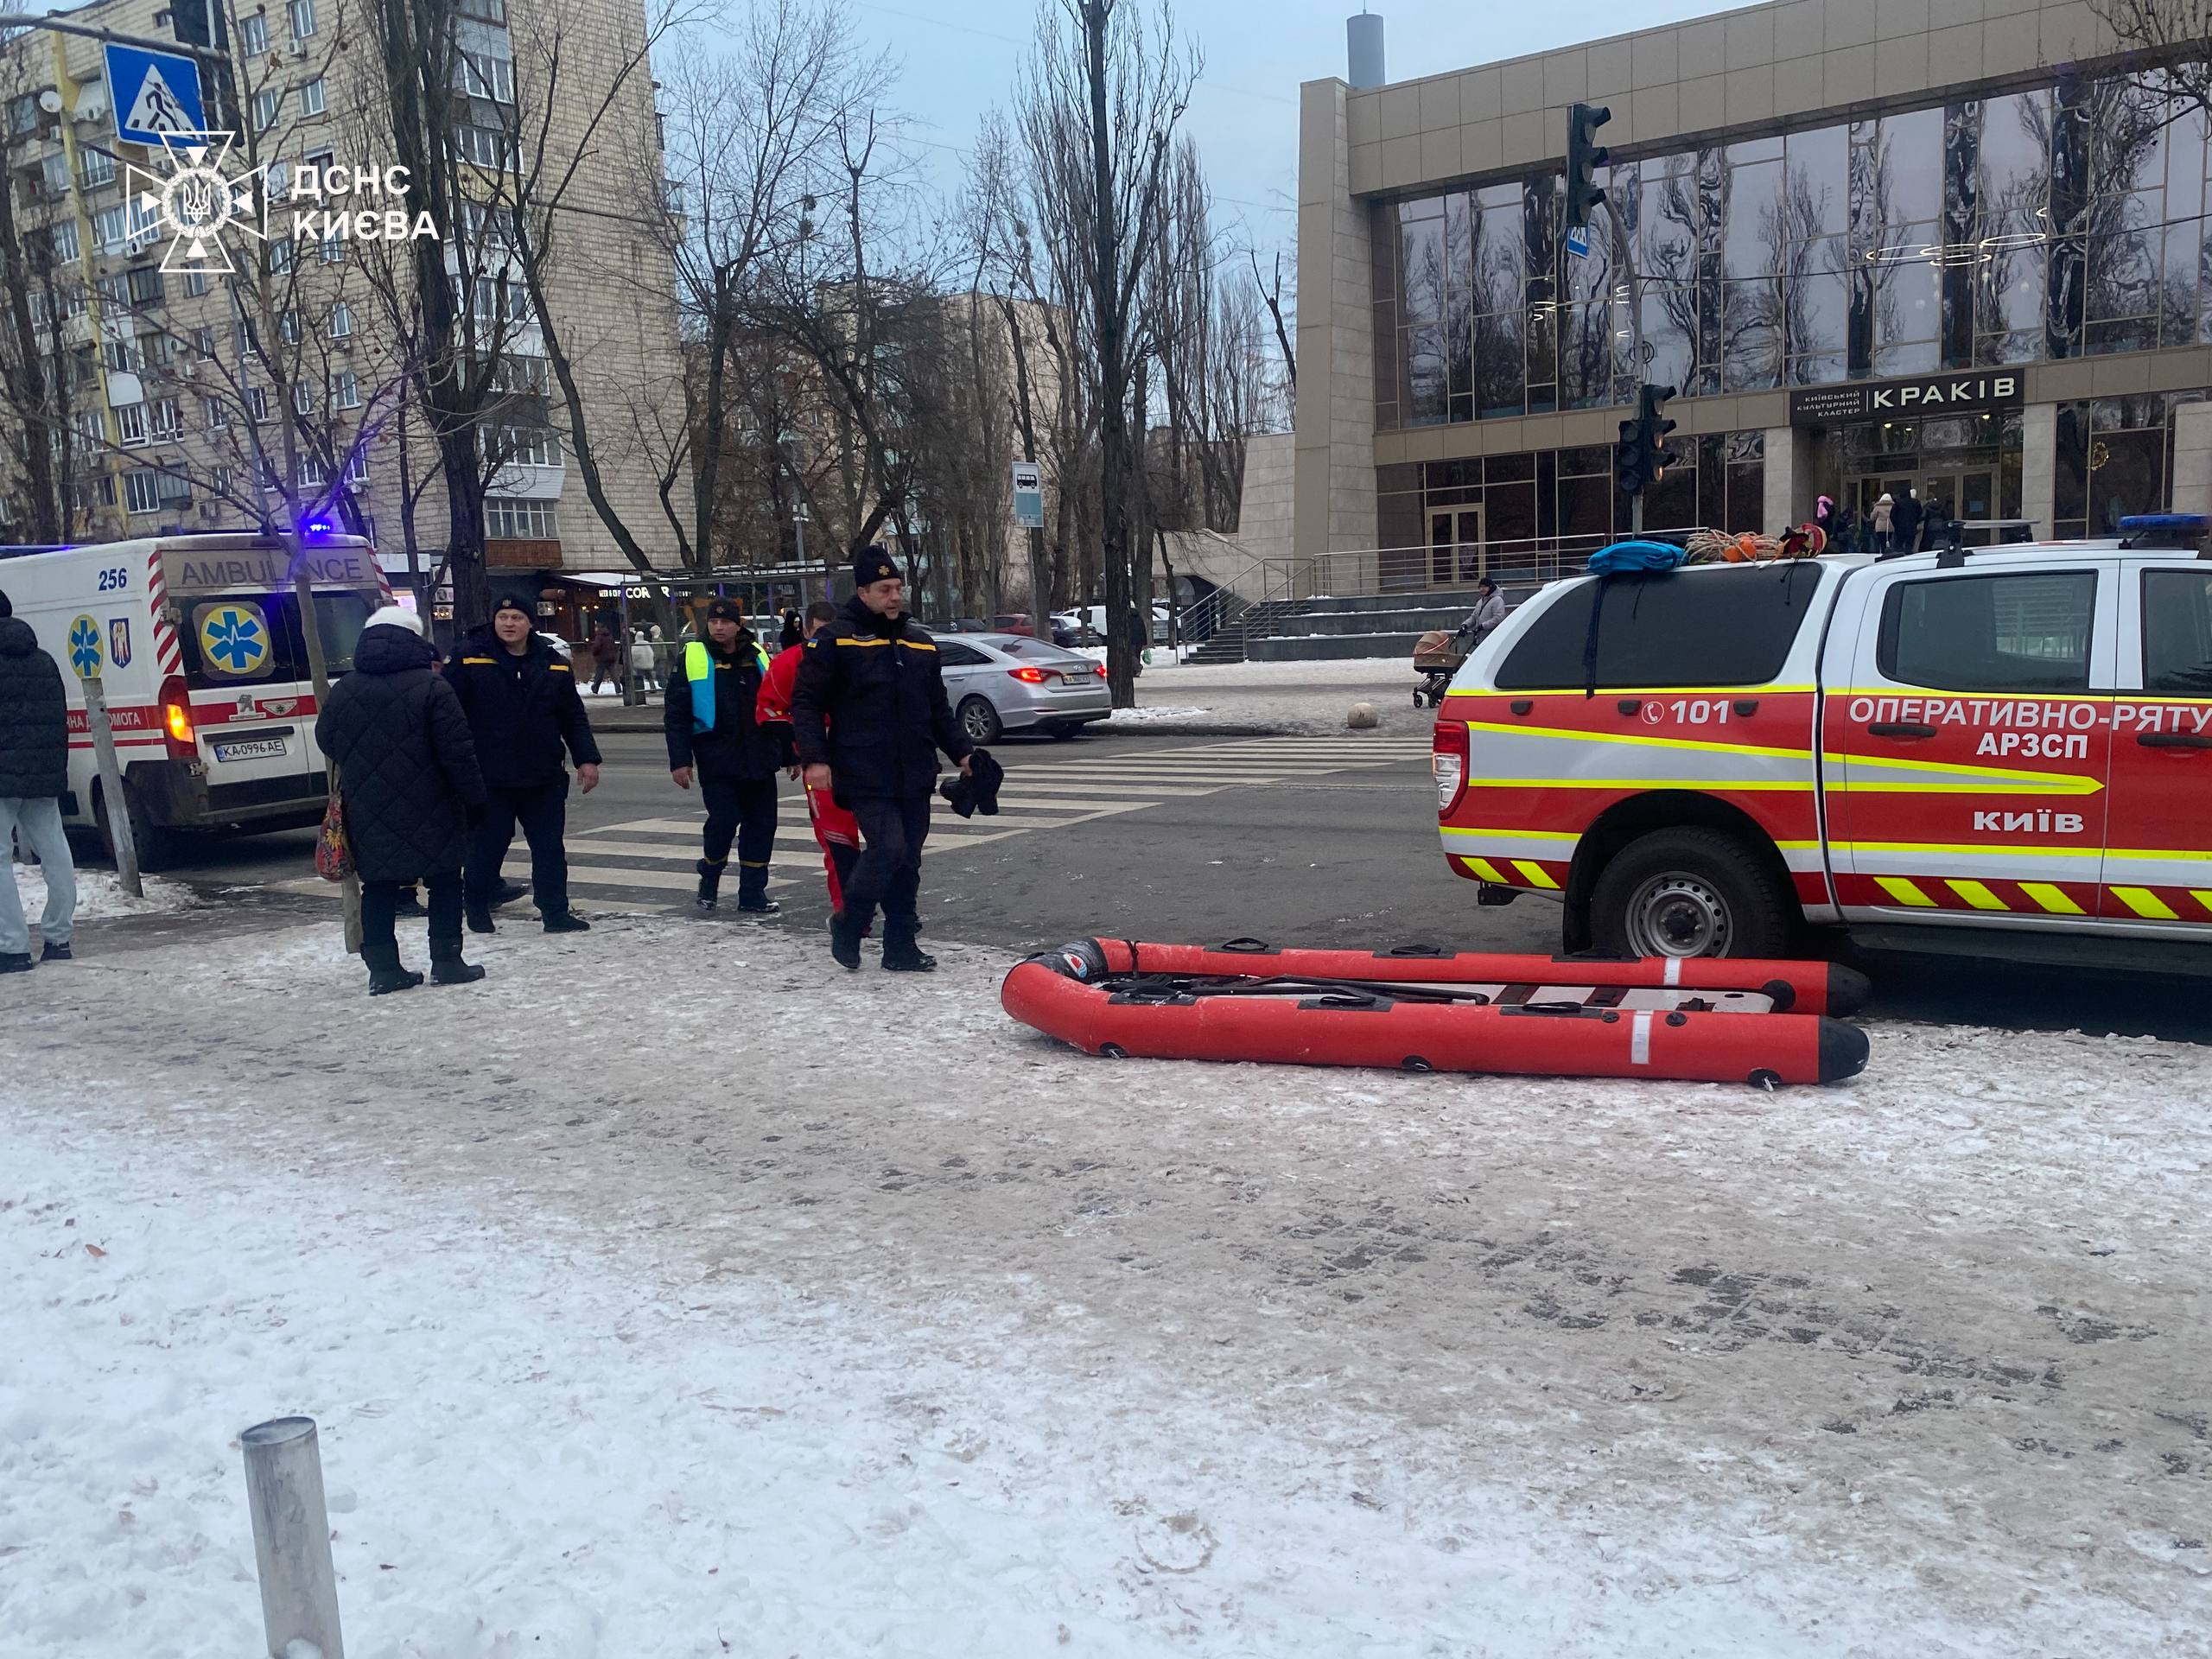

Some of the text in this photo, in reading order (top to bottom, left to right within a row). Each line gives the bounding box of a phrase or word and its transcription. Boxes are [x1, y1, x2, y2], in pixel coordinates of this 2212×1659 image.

[1796, 398, 1860, 410] КУЛЬТУРНИЙ
[1805, 391, 1860, 402] КИЇВСЬКИЙ
[1873, 378, 2015, 409] КРАКІВ
[1817, 408, 1860, 417] КЛАСТЕР
[99, 568, 128, 591] 256
[1670, 700, 1729, 724] 101
[224, 741, 283, 757] KA 0996 AE
[1976, 733, 2088, 760] АРЗСП
[1974, 809, 2084, 834] КИЇВ
